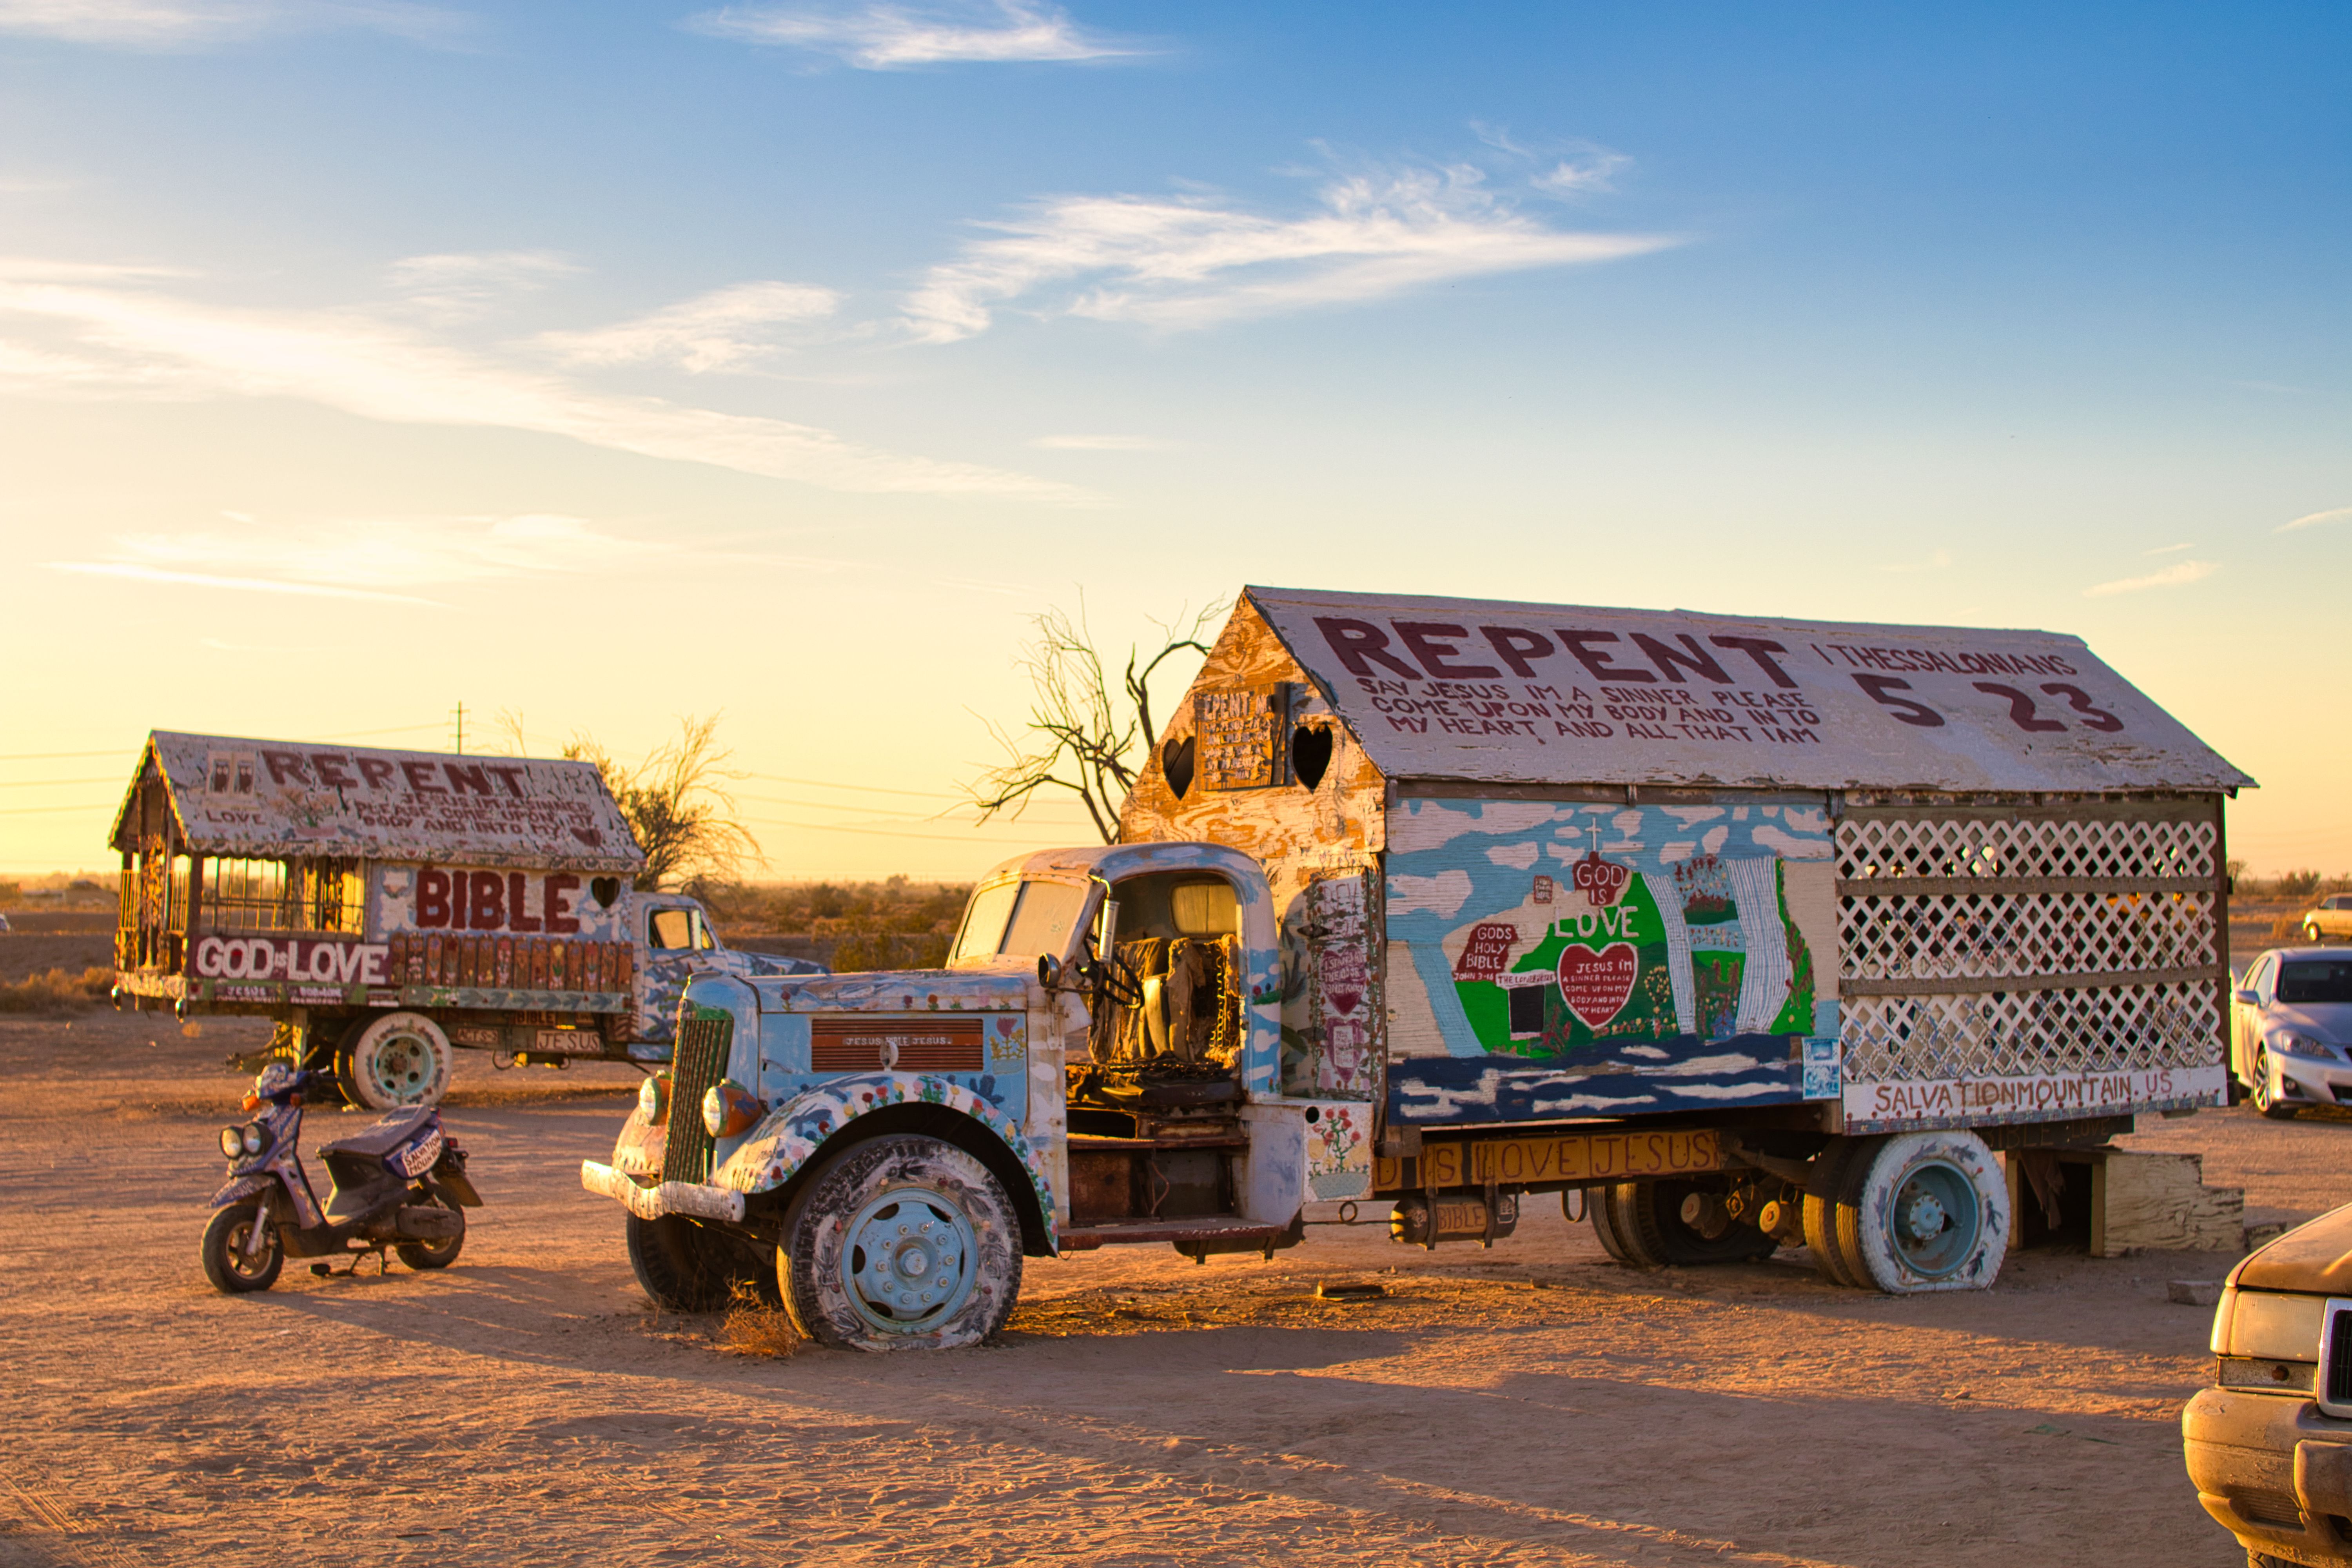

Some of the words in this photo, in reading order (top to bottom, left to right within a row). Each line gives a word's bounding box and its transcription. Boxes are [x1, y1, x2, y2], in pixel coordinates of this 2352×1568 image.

[1312, 617, 1798, 688] REPENT
[1827, 644, 2077, 675] THESSALONIANS
[1356, 678, 1409, 695] SAY
[1421, 681, 1510, 699] JESUS
[1573, 686, 1593, 701] A
[1600, 687, 1699, 705] SINNER
[1711, 691, 1814, 707] PLEASE
[1851, 673, 1945, 728] 5
[1972, 682, 2124, 733] 23
[1372, 696, 1459, 716] COME
[1460, 701, 1552, 718] UPON
[1555, 703, 1593, 719] MY
[1604, 705, 1667, 721] BODY
[1679, 708, 1734, 723] AND
[1386, 715, 1427, 733] MY
[1437, 718, 1537, 735] HEART
[1555, 721, 1613, 738] AND
[1626, 723, 1678, 739] ALL
[1672, 724, 1752, 742] THAT
[1760, 727, 1777, 742] I
[1776, 728, 1820, 743] AM
[261, 750, 525, 797] REPENT
[205, 809, 267, 825] LOVE
[354, 800, 433, 818] PLEASE
[440, 807, 487, 821] COME
[501, 810, 554, 822] UPON
[568, 814, 593, 827] MY
[525, 800, 591, 812] SINNER
[423, 819, 466, 832] AND
[475, 822, 523, 834] INTO
[530, 824, 561, 839] MY
[1577, 864, 1624, 887] GOD
[416, 870, 580, 933] BIBLE
[1591, 888, 1606, 904] IS
[1477, 927, 1512, 940] GODS
[1554, 906, 1639, 938] LOVE
[197, 936, 274, 979] GOD
[274, 951, 288, 968] IS
[287, 940, 389, 984] LOVE
[1475, 942, 1506, 955] HOLY
[1466, 953, 1501, 969] BIBLE
[1576, 961, 1613, 974] JESUS
[1453, 972, 1475, 981] JOHN
[1498, 975, 1513, 984] THE
[1570, 974, 1600, 982] SINNER
[517, 1011, 555, 1024] BIBLE
[539, 1032, 600, 1049] JESUS
[2072, 1119, 2110, 1138] LOVE
[406, 1135, 440, 1165] SALVATION
[1476, 1139, 1577, 1181] LOVE
[1595, 1132, 1711, 1174] JESUS
[1437, 1205, 1485, 1230] BIBLE
